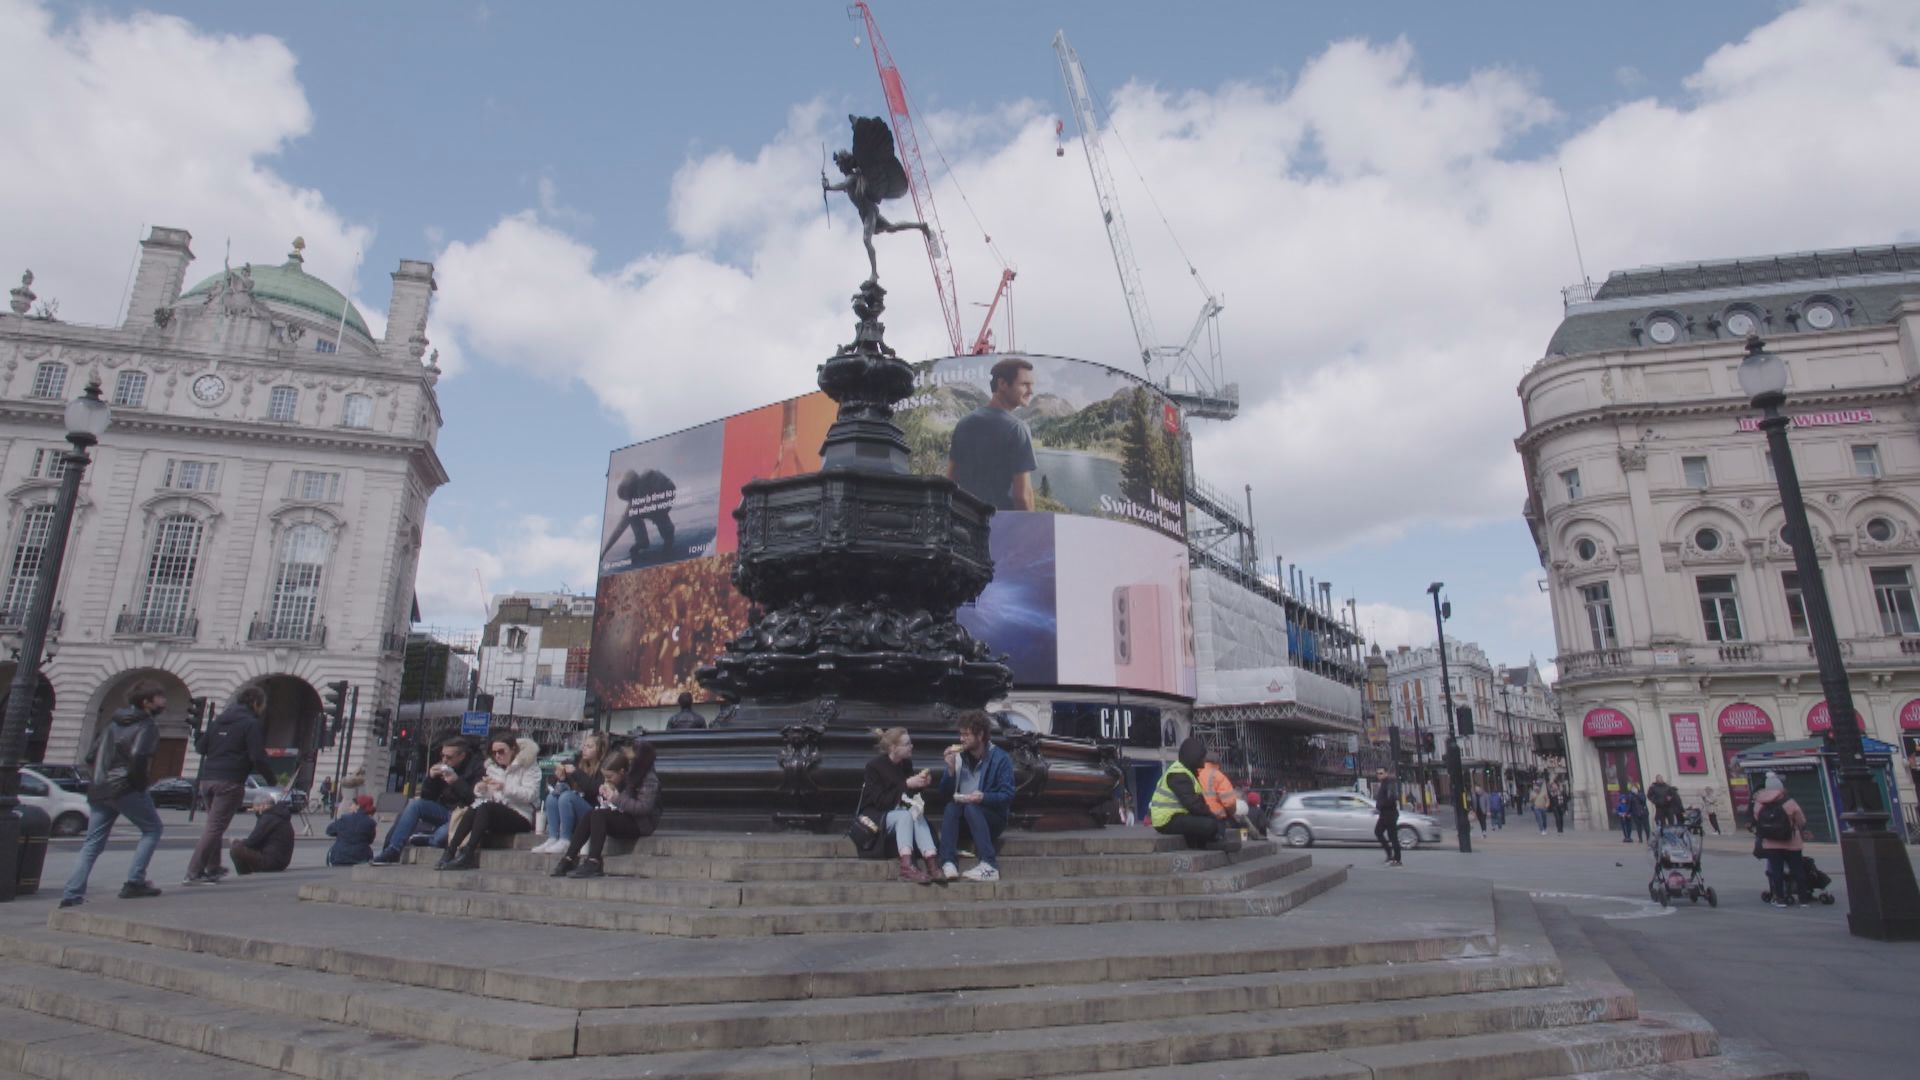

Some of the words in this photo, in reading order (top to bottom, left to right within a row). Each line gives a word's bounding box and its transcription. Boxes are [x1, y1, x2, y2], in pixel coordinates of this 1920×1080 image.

[1792, 409, 1872, 427] WORLDS
[1100, 493, 1184, 537] Switzerland.
[1151, 487, 1155, 505] I
[1157, 494, 1181, 517] need
[1100, 708, 1132, 739] GAP
